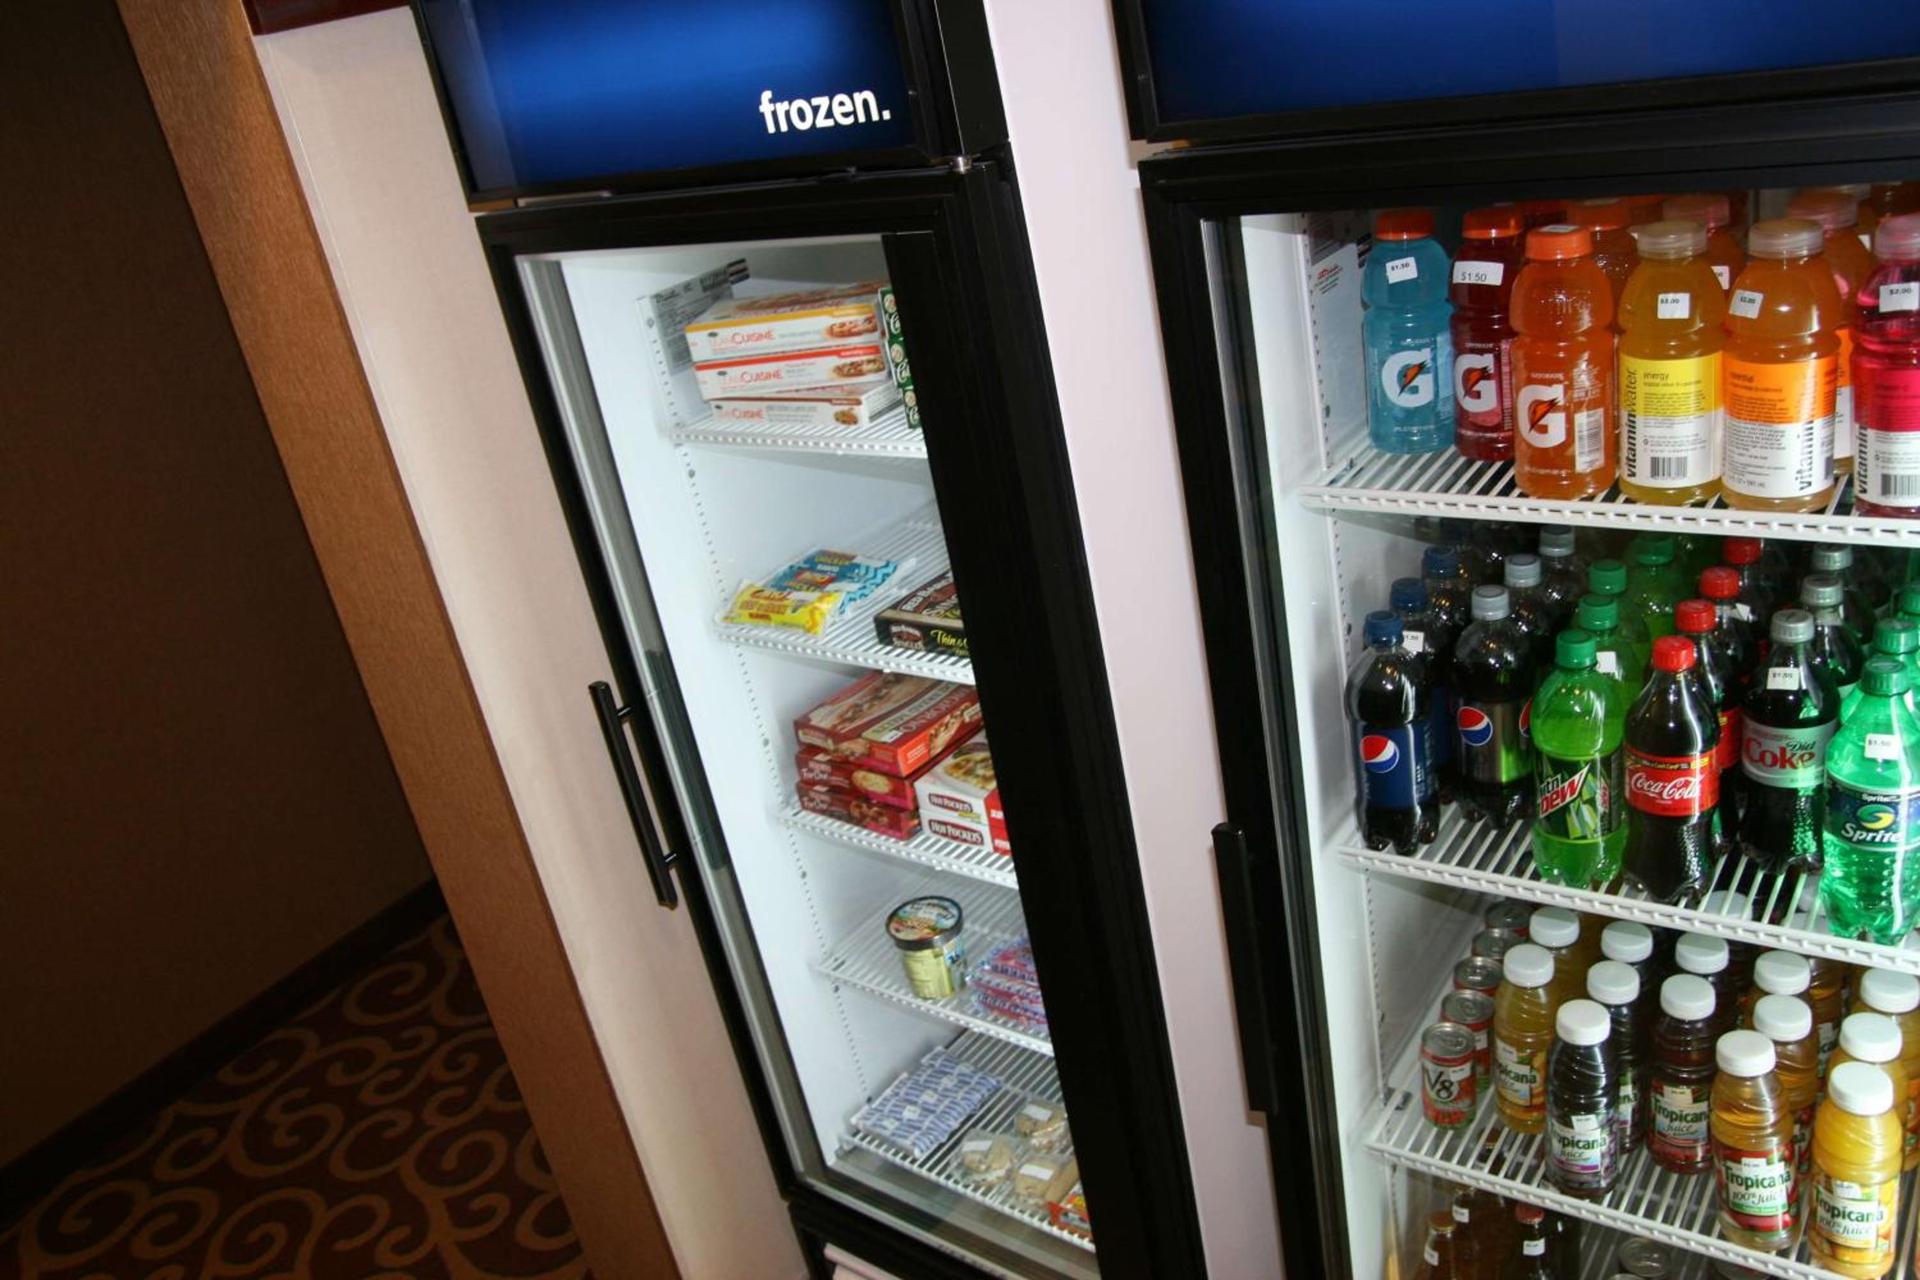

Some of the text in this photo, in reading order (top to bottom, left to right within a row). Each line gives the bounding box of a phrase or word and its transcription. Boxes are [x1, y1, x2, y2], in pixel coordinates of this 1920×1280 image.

[759, 90, 891, 134] frozen.
[1382, 347, 1434, 408] G
[1454, 353, 1498, 413] G
[1517, 384, 1567, 449] G
[1744, 736, 1816, 770] Coke
[1424, 1068, 1455, 1101] V8
[1650, 1093, 1708, 1124] Tropican
